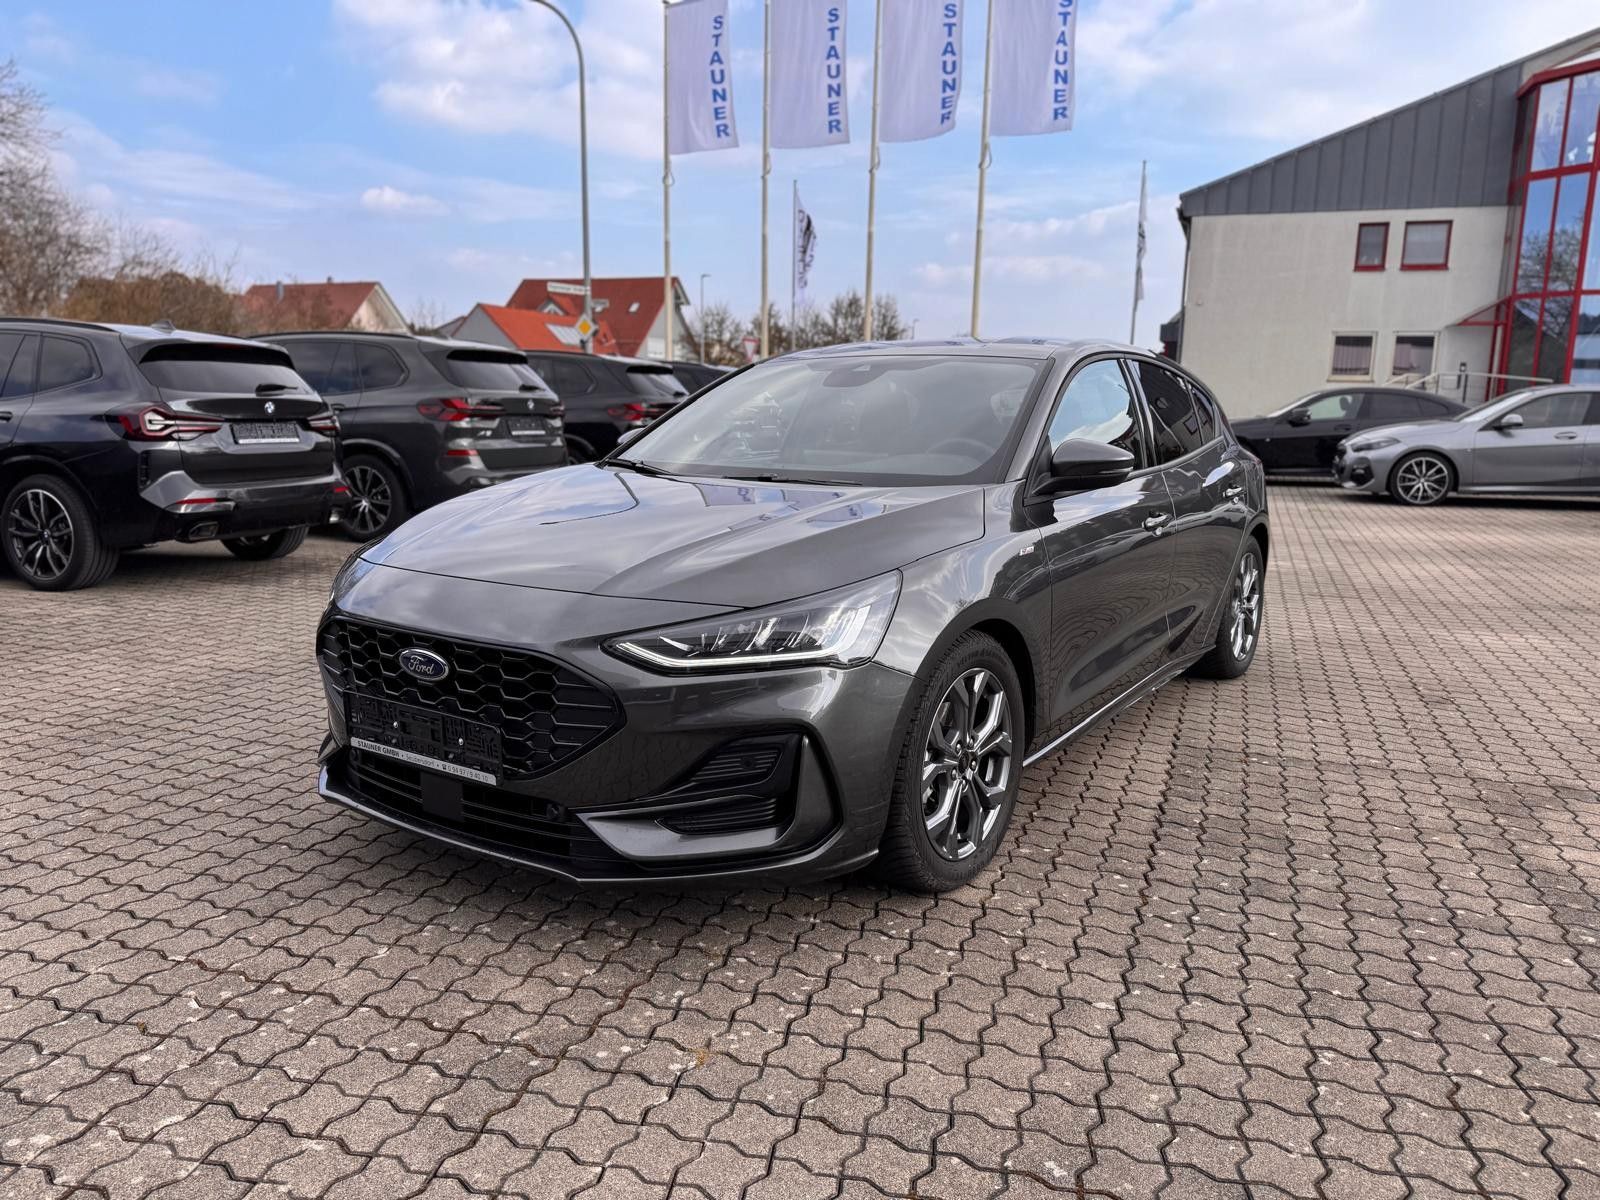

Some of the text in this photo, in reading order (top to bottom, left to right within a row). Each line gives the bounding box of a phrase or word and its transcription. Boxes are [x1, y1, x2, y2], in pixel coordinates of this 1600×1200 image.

[709, 15, 730, 138] STAUNER
[825, 7, 842, 134] STAUNER
[1053, 0, 1073, 120] STAUNER
[408, 655, 435, 675] Ford
[357, 740, 381, 753] STAUNER
